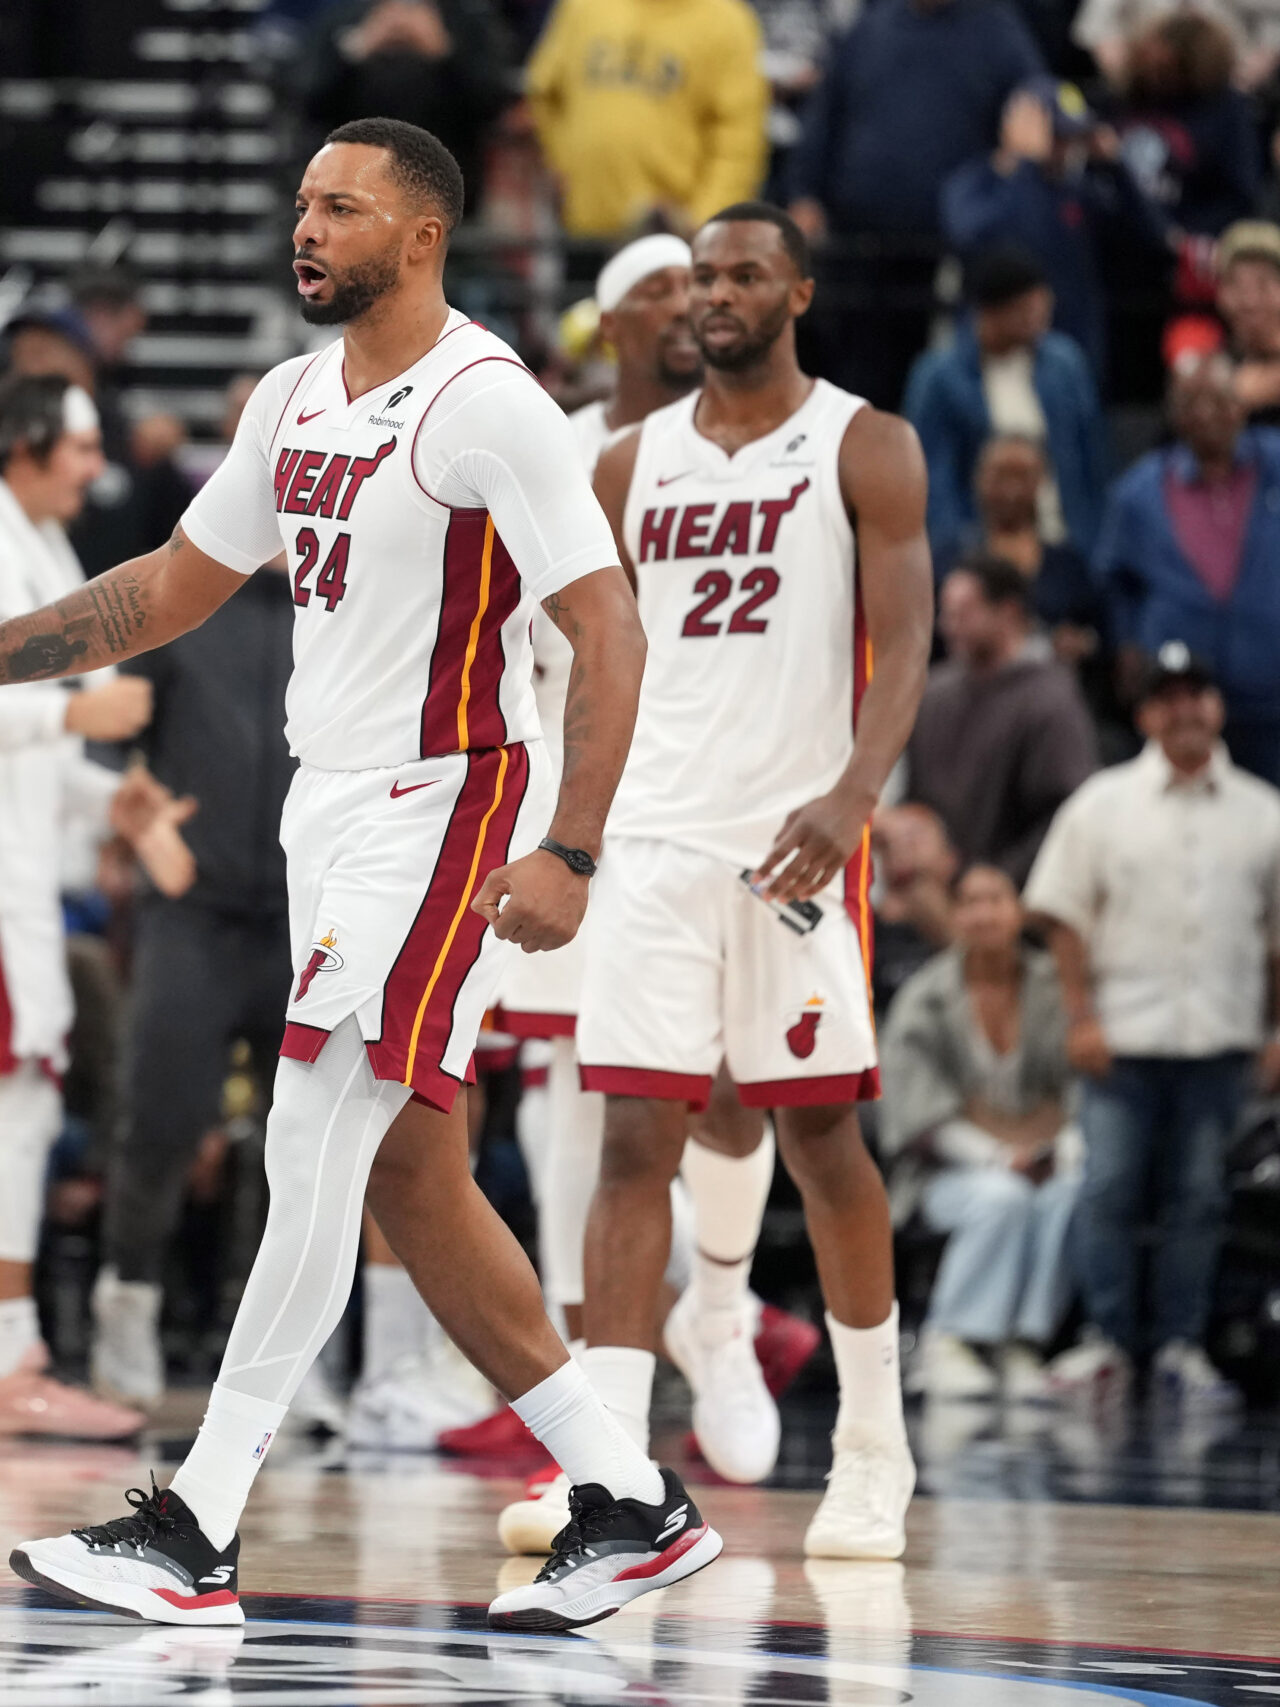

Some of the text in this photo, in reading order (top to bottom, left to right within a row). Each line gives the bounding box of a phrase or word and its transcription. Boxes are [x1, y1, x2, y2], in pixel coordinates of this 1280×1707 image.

[368, 414, 406, 430] Robinhood
[274, 434, 398, 522] HEAT
[639, 476, 811, 564] HEAT
[294, 526, 352, 613] 24
[680, 566, 781, 638] 22
